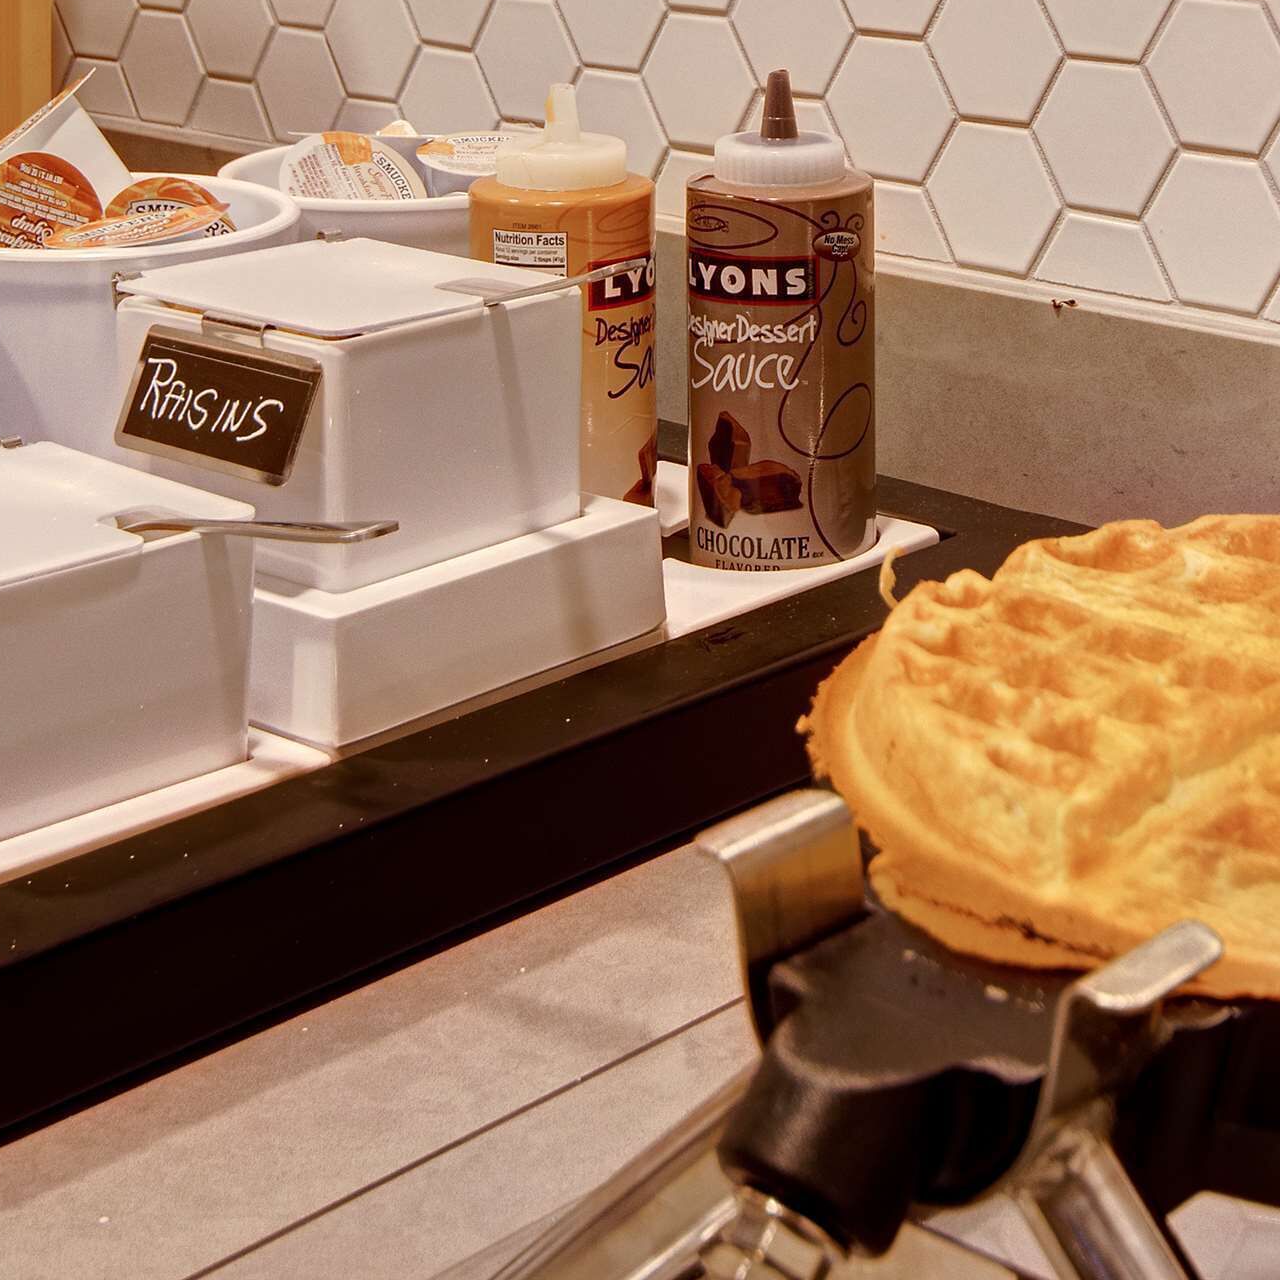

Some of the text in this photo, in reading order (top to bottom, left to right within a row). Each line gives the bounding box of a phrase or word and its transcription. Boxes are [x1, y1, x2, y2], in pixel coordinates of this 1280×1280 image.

[11, 214, 54, 243] Syrup
[495, 231, 565, 246] Nutrition Facts
[823, 234, 856, 245] No Mess
[689, 258, 807, 296] LYONS
[595, 312, 652, 346] Designer
[688, 310, 817, 347] esigner Dessert
[691, 337, 801, 392] Sauce
[139, 357, 285, 442] RAISINS
[696, 526, 810, 561] CHOCOLATE
[715, 560, 781, 572] FLAVORED
